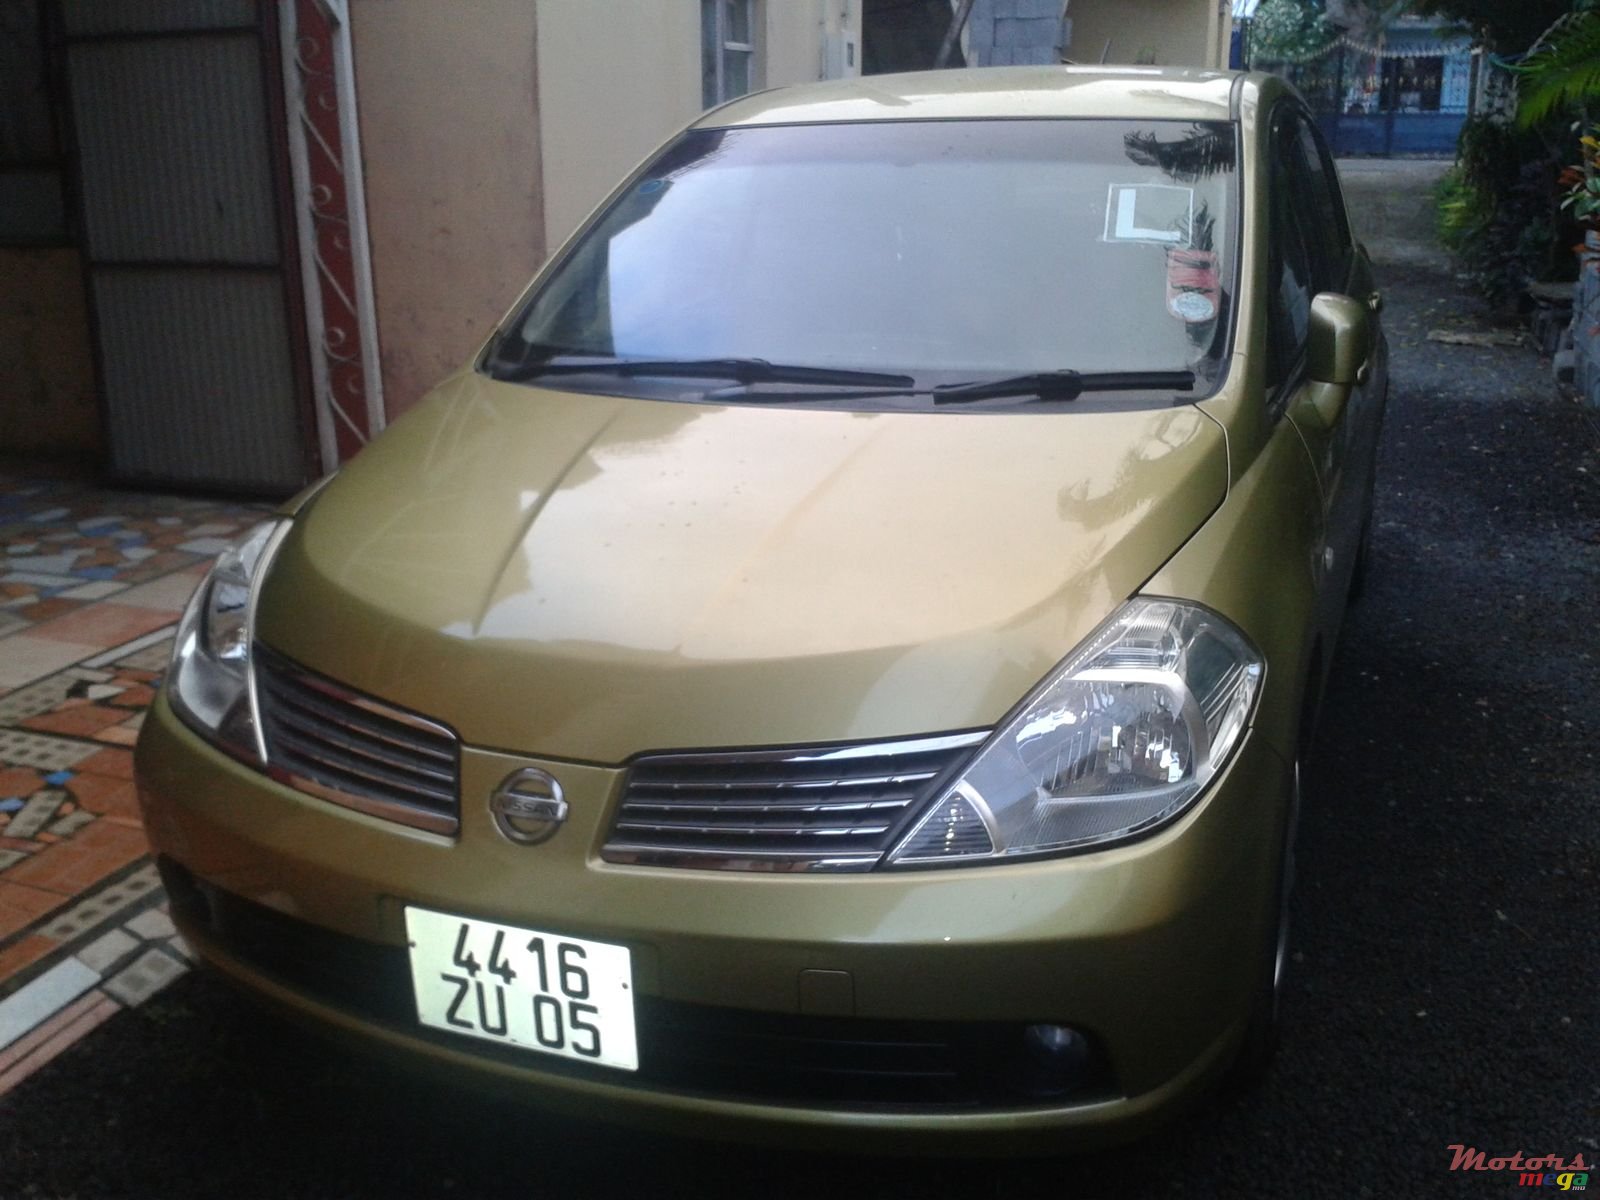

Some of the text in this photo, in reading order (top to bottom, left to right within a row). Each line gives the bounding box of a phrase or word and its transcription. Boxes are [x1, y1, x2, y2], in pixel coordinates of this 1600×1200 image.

[1115, 188, 1181, 241] L
[502, 799, 558, 816] SSN
[453, 922, 590, 1001] 4416
[441, 972, 602, 1058] ZU 05
